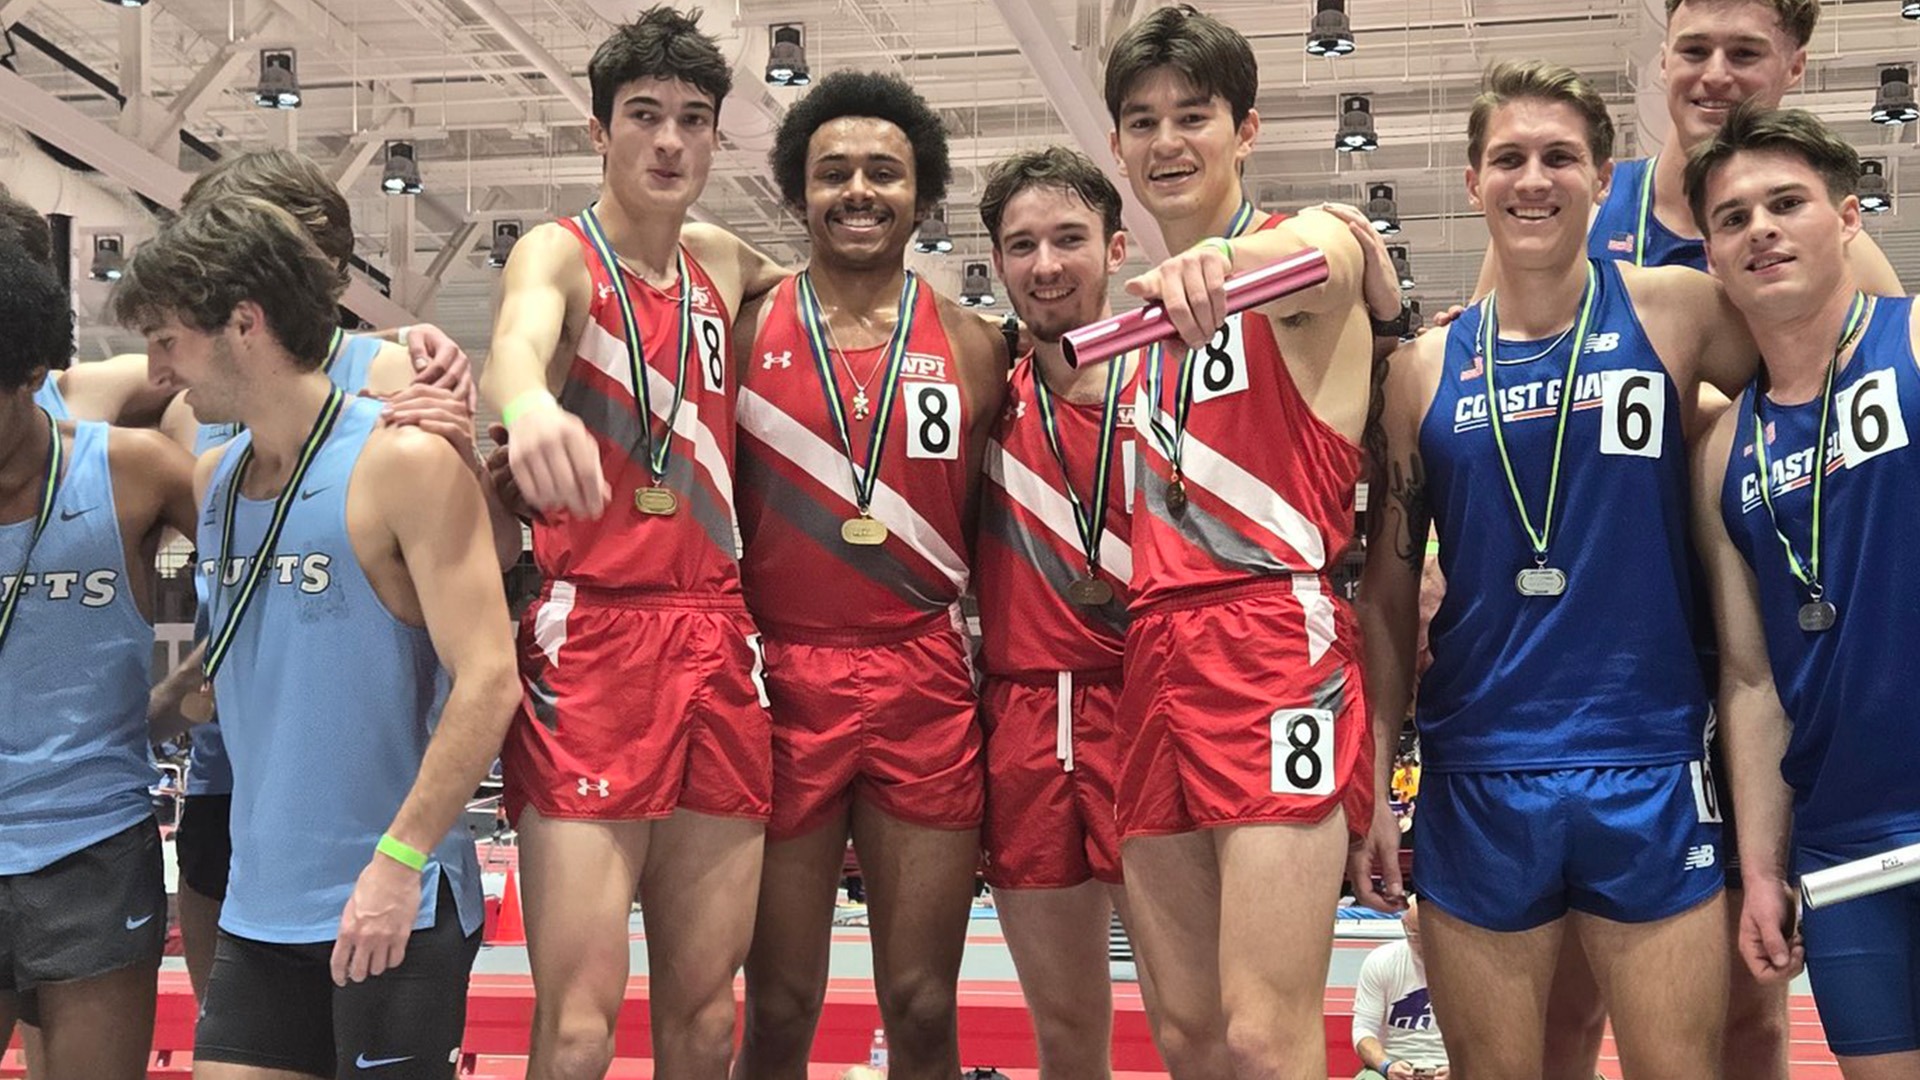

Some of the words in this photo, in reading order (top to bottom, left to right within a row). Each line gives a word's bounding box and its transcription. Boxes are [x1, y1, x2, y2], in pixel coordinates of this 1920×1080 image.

[703, 320, 722, 389] 8
[1203, 323, 1234, 391] 8
[918, 387, 950, 453] 8
[1617, 376, 1651, 450] 6
[1851, 379, 1889, 452] 6
[1741, 447, 1816, 502] CAST
[1285, 713, 1322, 789] 8
